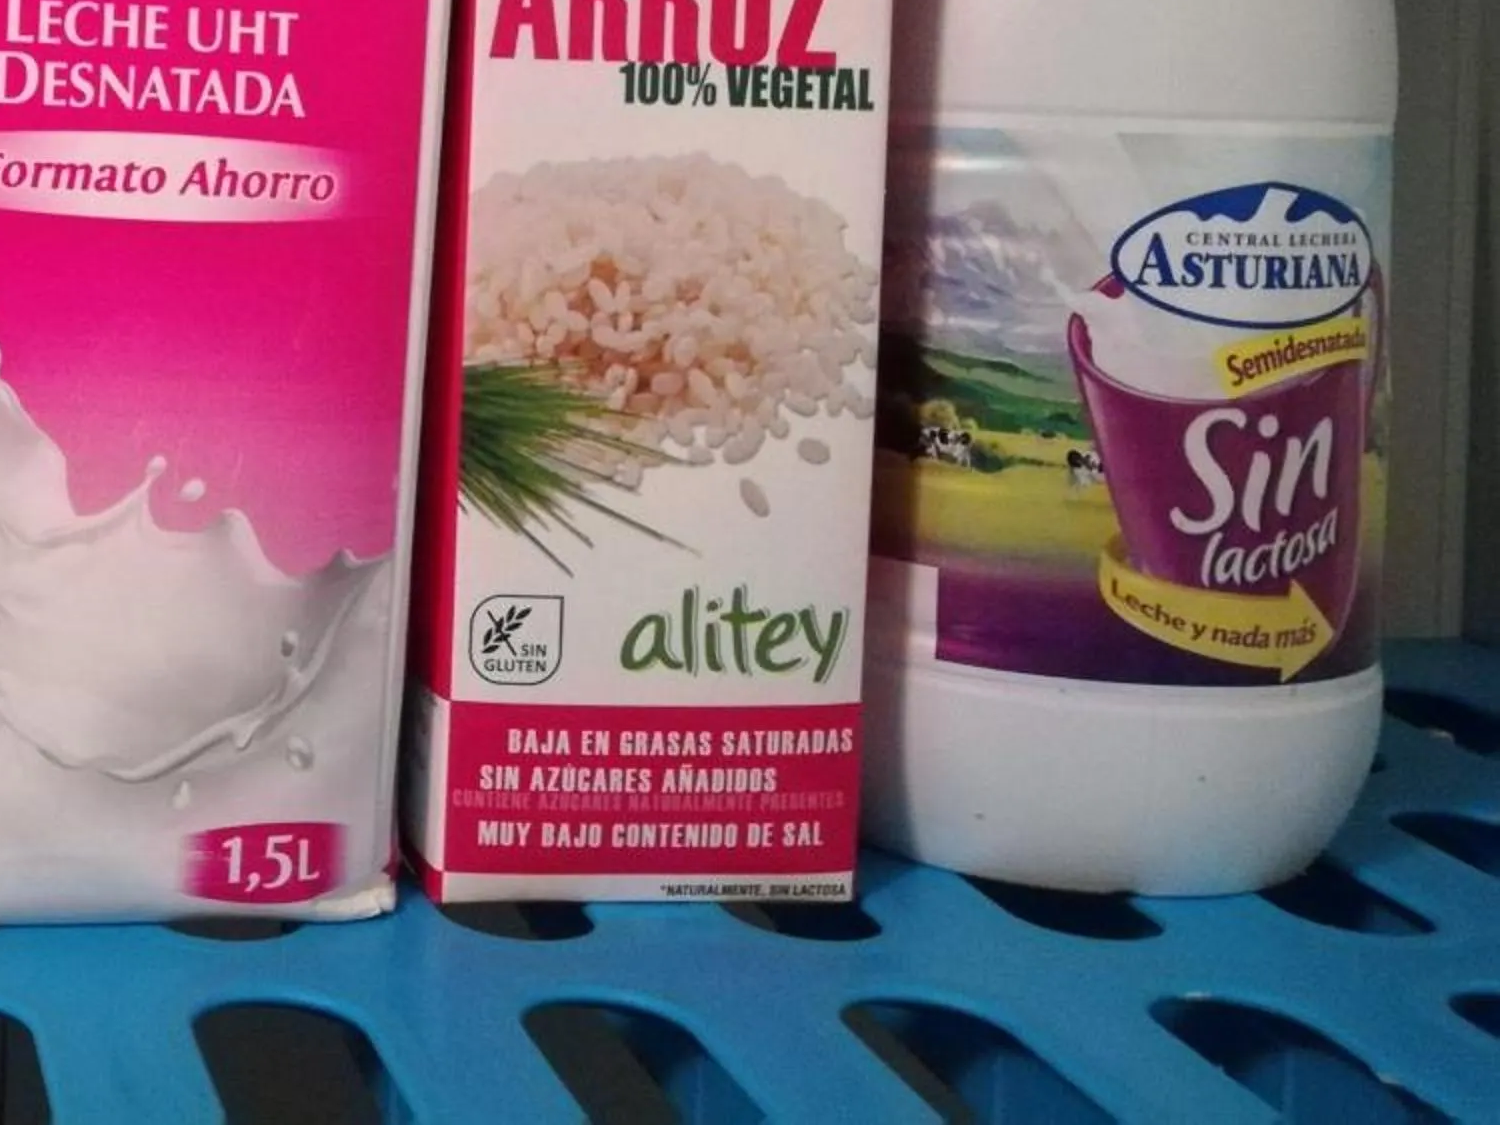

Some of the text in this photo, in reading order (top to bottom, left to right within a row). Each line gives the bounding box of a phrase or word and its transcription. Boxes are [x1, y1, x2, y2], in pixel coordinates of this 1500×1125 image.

[187, 7, 299, 57] UHT
[619, 61, 874, 111] 100% VEGETAL
[180, 158, 336, 201] Ahorro
[1136, 233, 1361, 290] ASTURIANA
[1187, 232, 1357, 248] CENTRAL LECHERA
[1226, 327, 1367, 388] Semidesnatada
[1169, 408, 1333, 535] Sin
[1201, 509, 1338, 587] lactosa
[620, 583, 850, 684] alitey
[1110, 578, 1317, 649] Leche y nada más
[484, 658, 548, 673] GLUTEN
[521, 643, 548, 658] SIN
[507, 728, 854, 757] BAJA EN GRASAS SATURADAS
[479, 762, 778, 794] SIN AZÚCARES AÑADIDOS
[477, 820, 825, 848] MUY BAJO CONTENIDO DE SAL
[222, 834, 321, 892] 1,5L
[792, 883, 846, 897] LACTOSA
